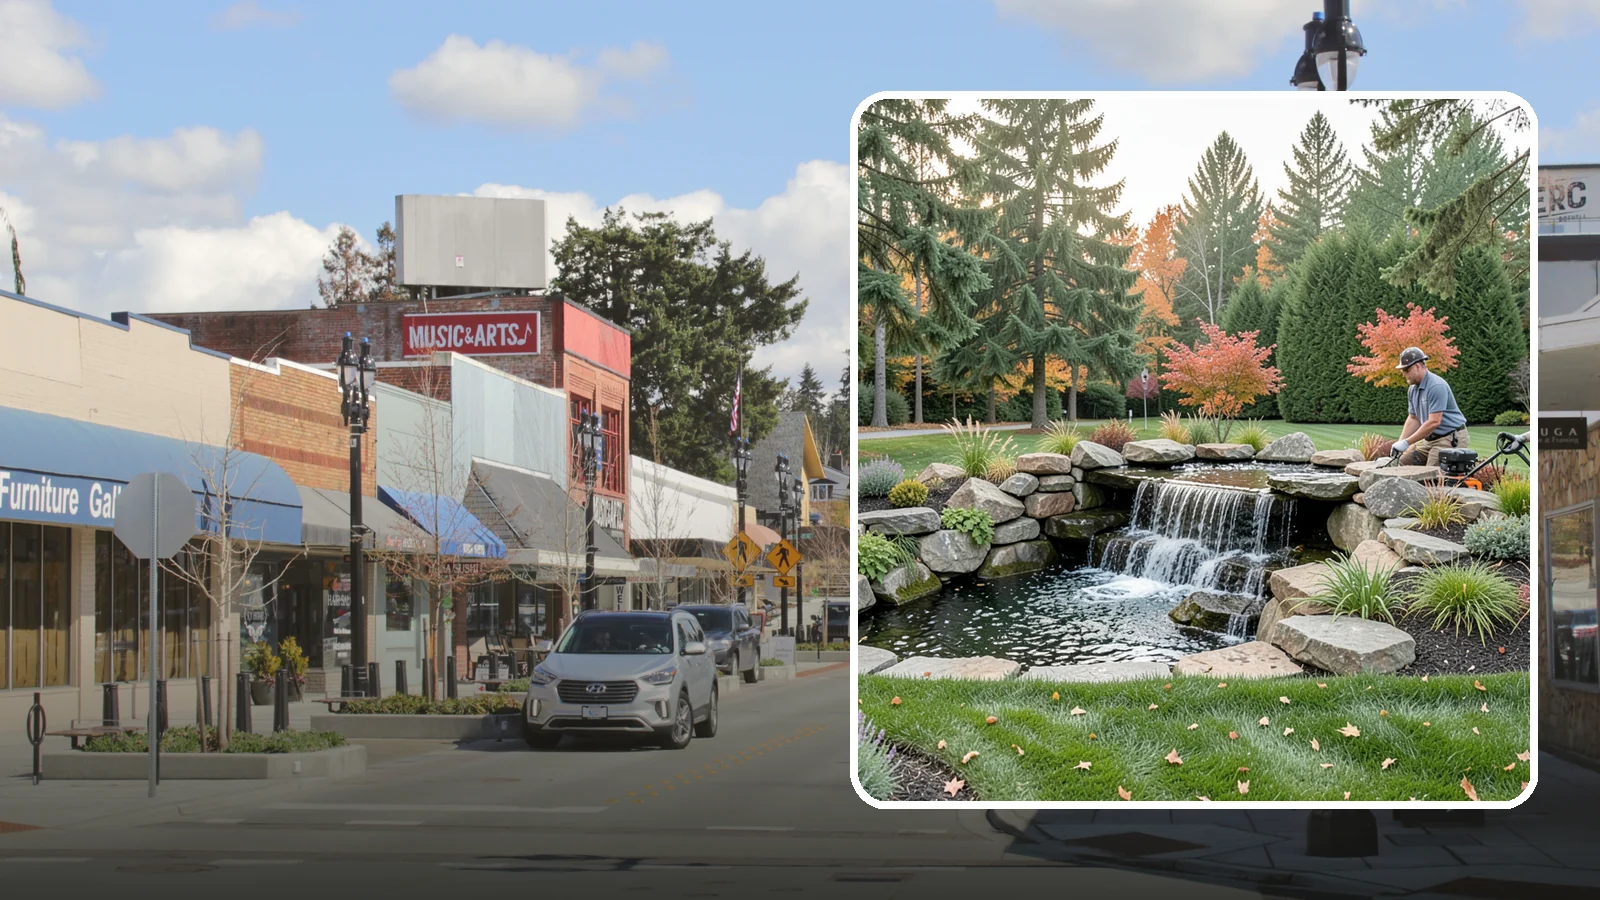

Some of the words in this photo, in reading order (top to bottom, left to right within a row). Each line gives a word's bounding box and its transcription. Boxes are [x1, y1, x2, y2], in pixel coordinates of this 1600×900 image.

[409, 323, 520, 348] MUSIC&ARTS
[1540, 428, 1577, 436] UGA
[0, 472, 79, 515] Furniture
[89, 483, 121, 519] Gal
[453, 563, 479, 573] SUSHI
